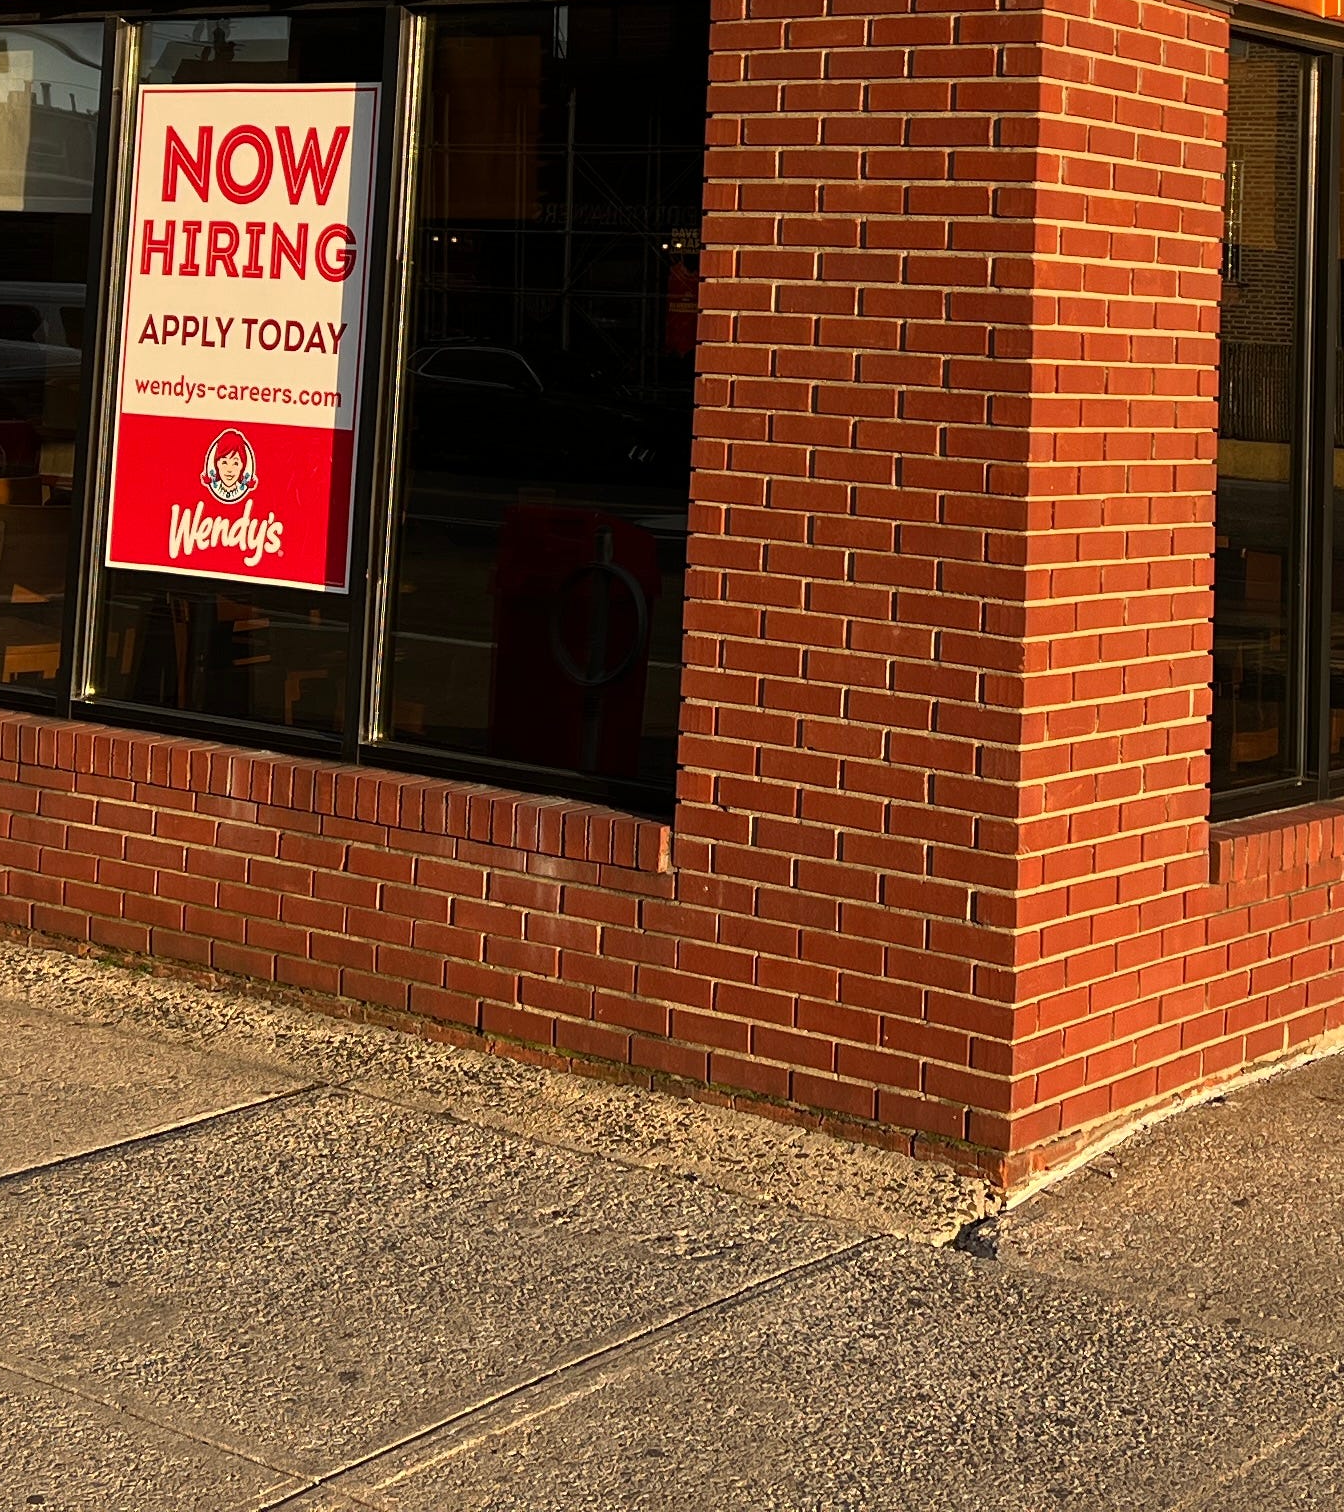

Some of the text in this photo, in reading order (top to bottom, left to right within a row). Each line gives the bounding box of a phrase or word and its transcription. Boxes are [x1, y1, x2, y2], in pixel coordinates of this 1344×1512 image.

[161, 124, 351, 206] NOW
[140, 219, 357, 284] HIRING
[137, 313, 348, 355] APPLY TODAY
[134, 374, 343, 408] wendys-careers.com
[168, 498, 284, 567] Wendy's
